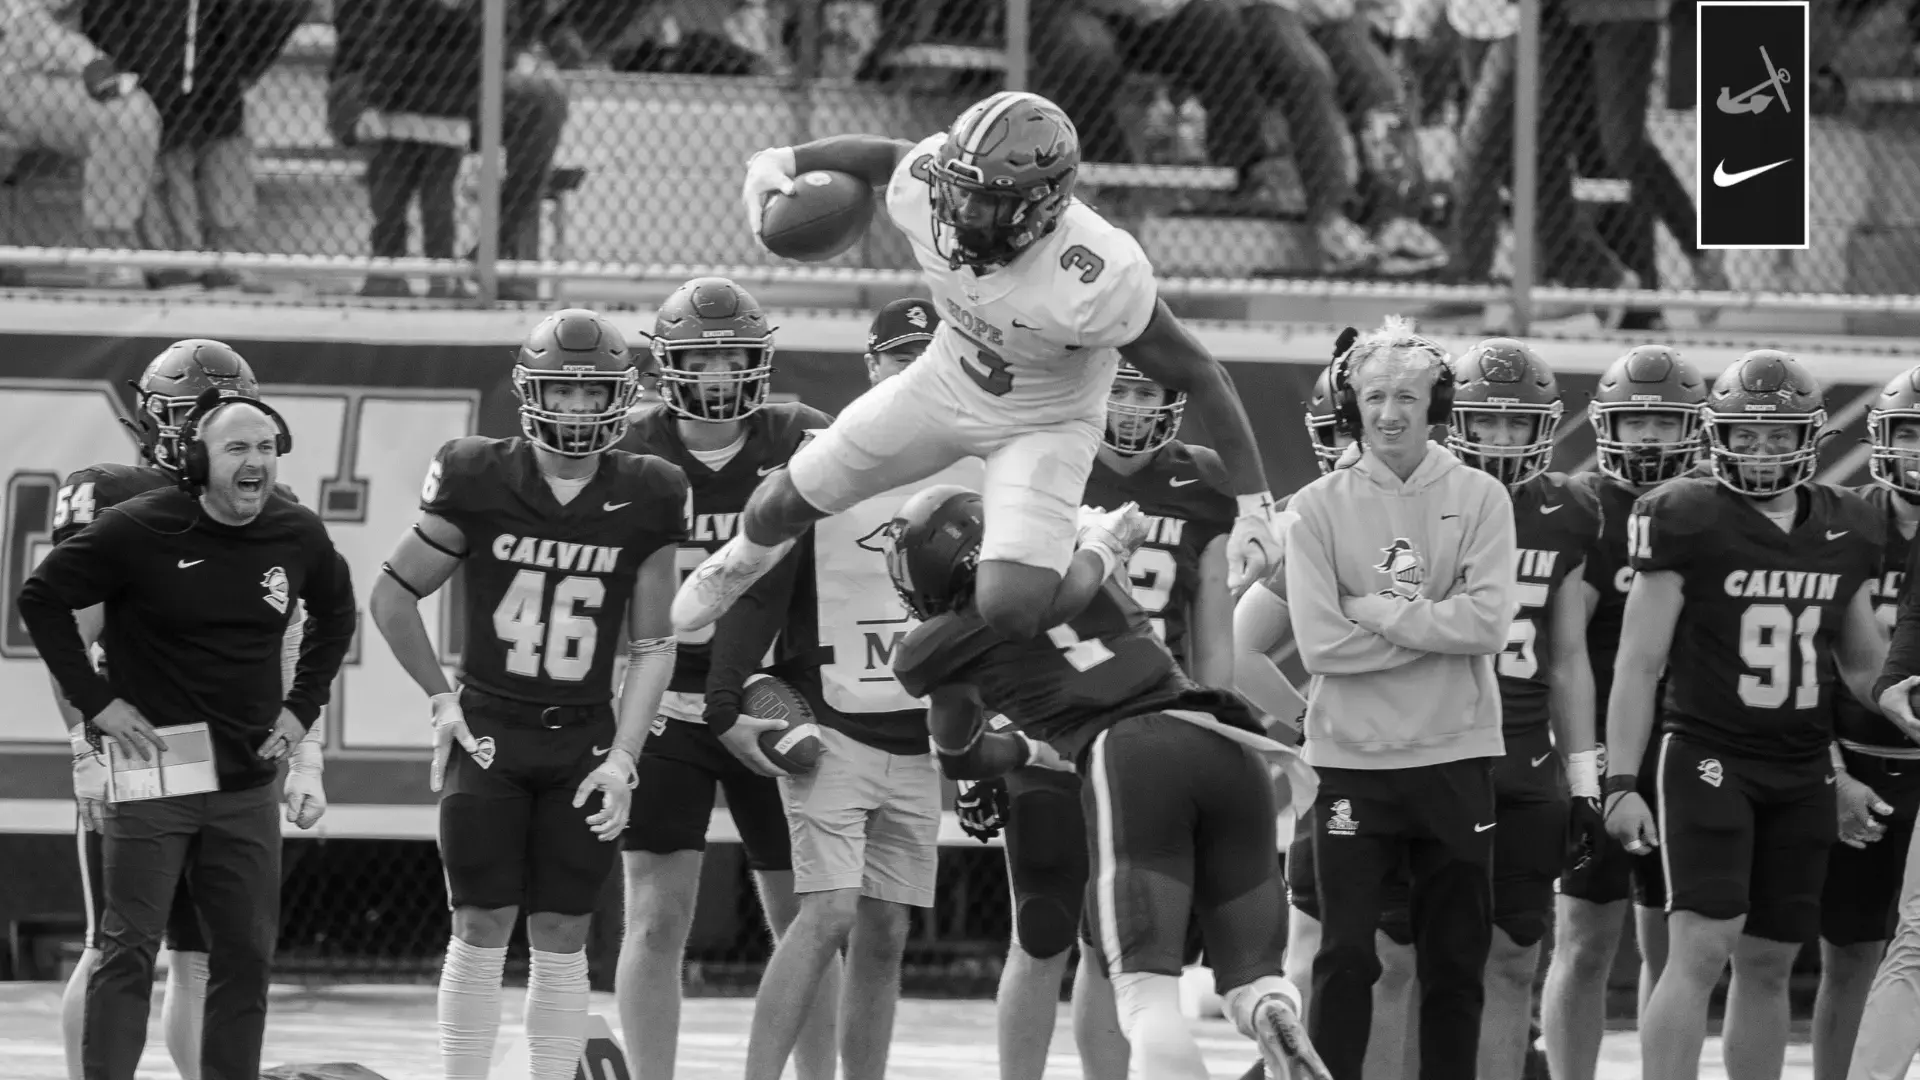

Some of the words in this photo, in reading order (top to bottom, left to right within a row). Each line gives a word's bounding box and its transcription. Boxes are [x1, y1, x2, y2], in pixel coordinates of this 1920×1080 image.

[1060, 244, 1104, 284] 3
[946, 297, 1004, 346] HOPE
[53, 482, 96, 529] 54
[492, 533, 623, 573] CALVIN
[1724, 569, 1842, 600] CALVIN
[492, 568, 606, 681] 46
[1737, 603, 1822, 710] 91
